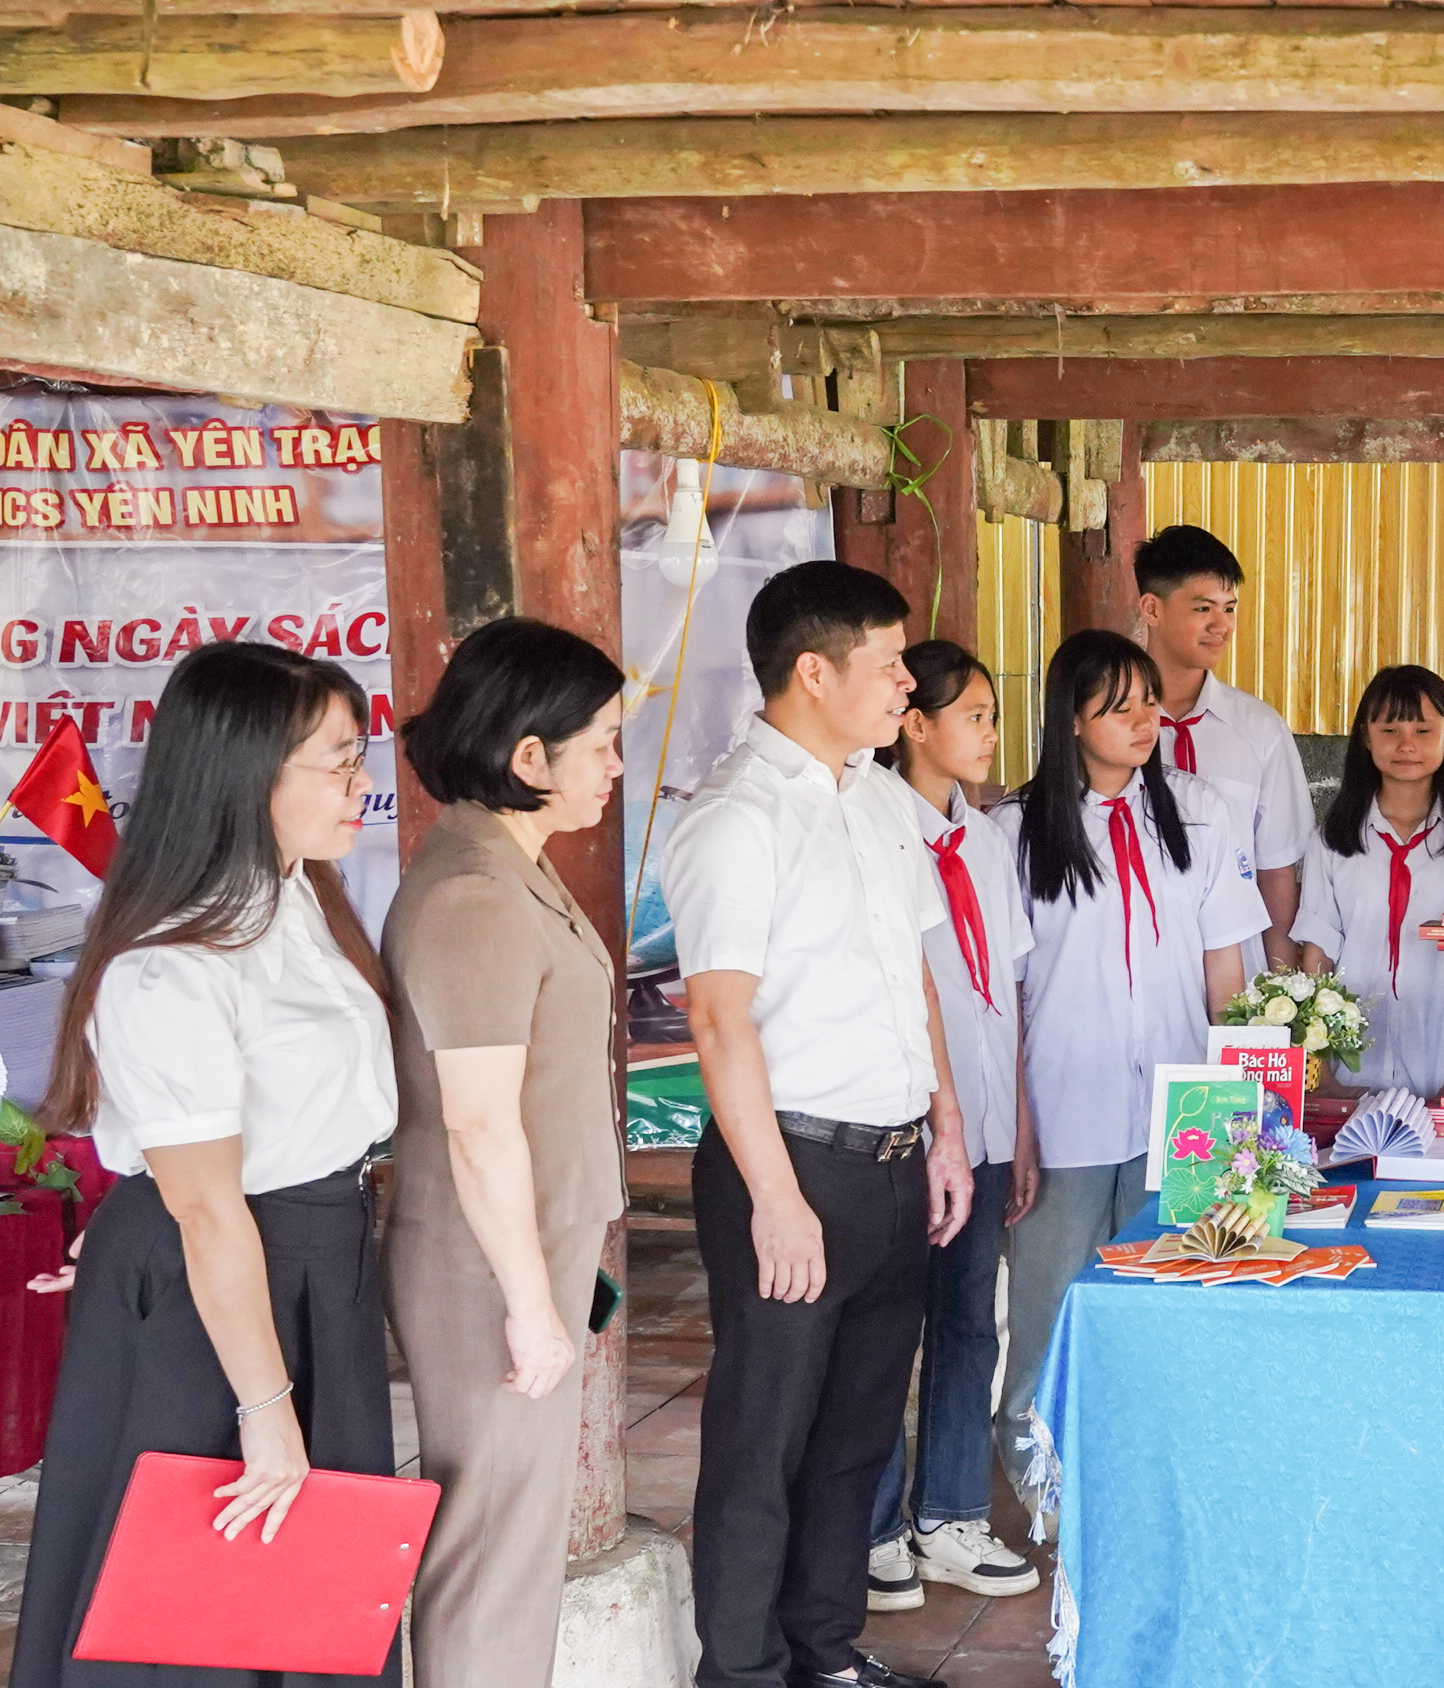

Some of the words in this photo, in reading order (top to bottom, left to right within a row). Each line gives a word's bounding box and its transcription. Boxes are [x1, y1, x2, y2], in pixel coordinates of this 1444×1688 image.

[0, 423, 71, 469] ÂN
[89, 424, 159, 468] XÃ
[170, 422, 263, 467] YÊN
[0, 490, 61, 527] CS
[74, 484, 174, 527] YÊN
[186, 488, 295, 524] NINH
[267, 603, 391, 657] SÁC
[1238, 1052, 1265, 1069] Bác
[1266, 1066, 1293, 1082] mãi
